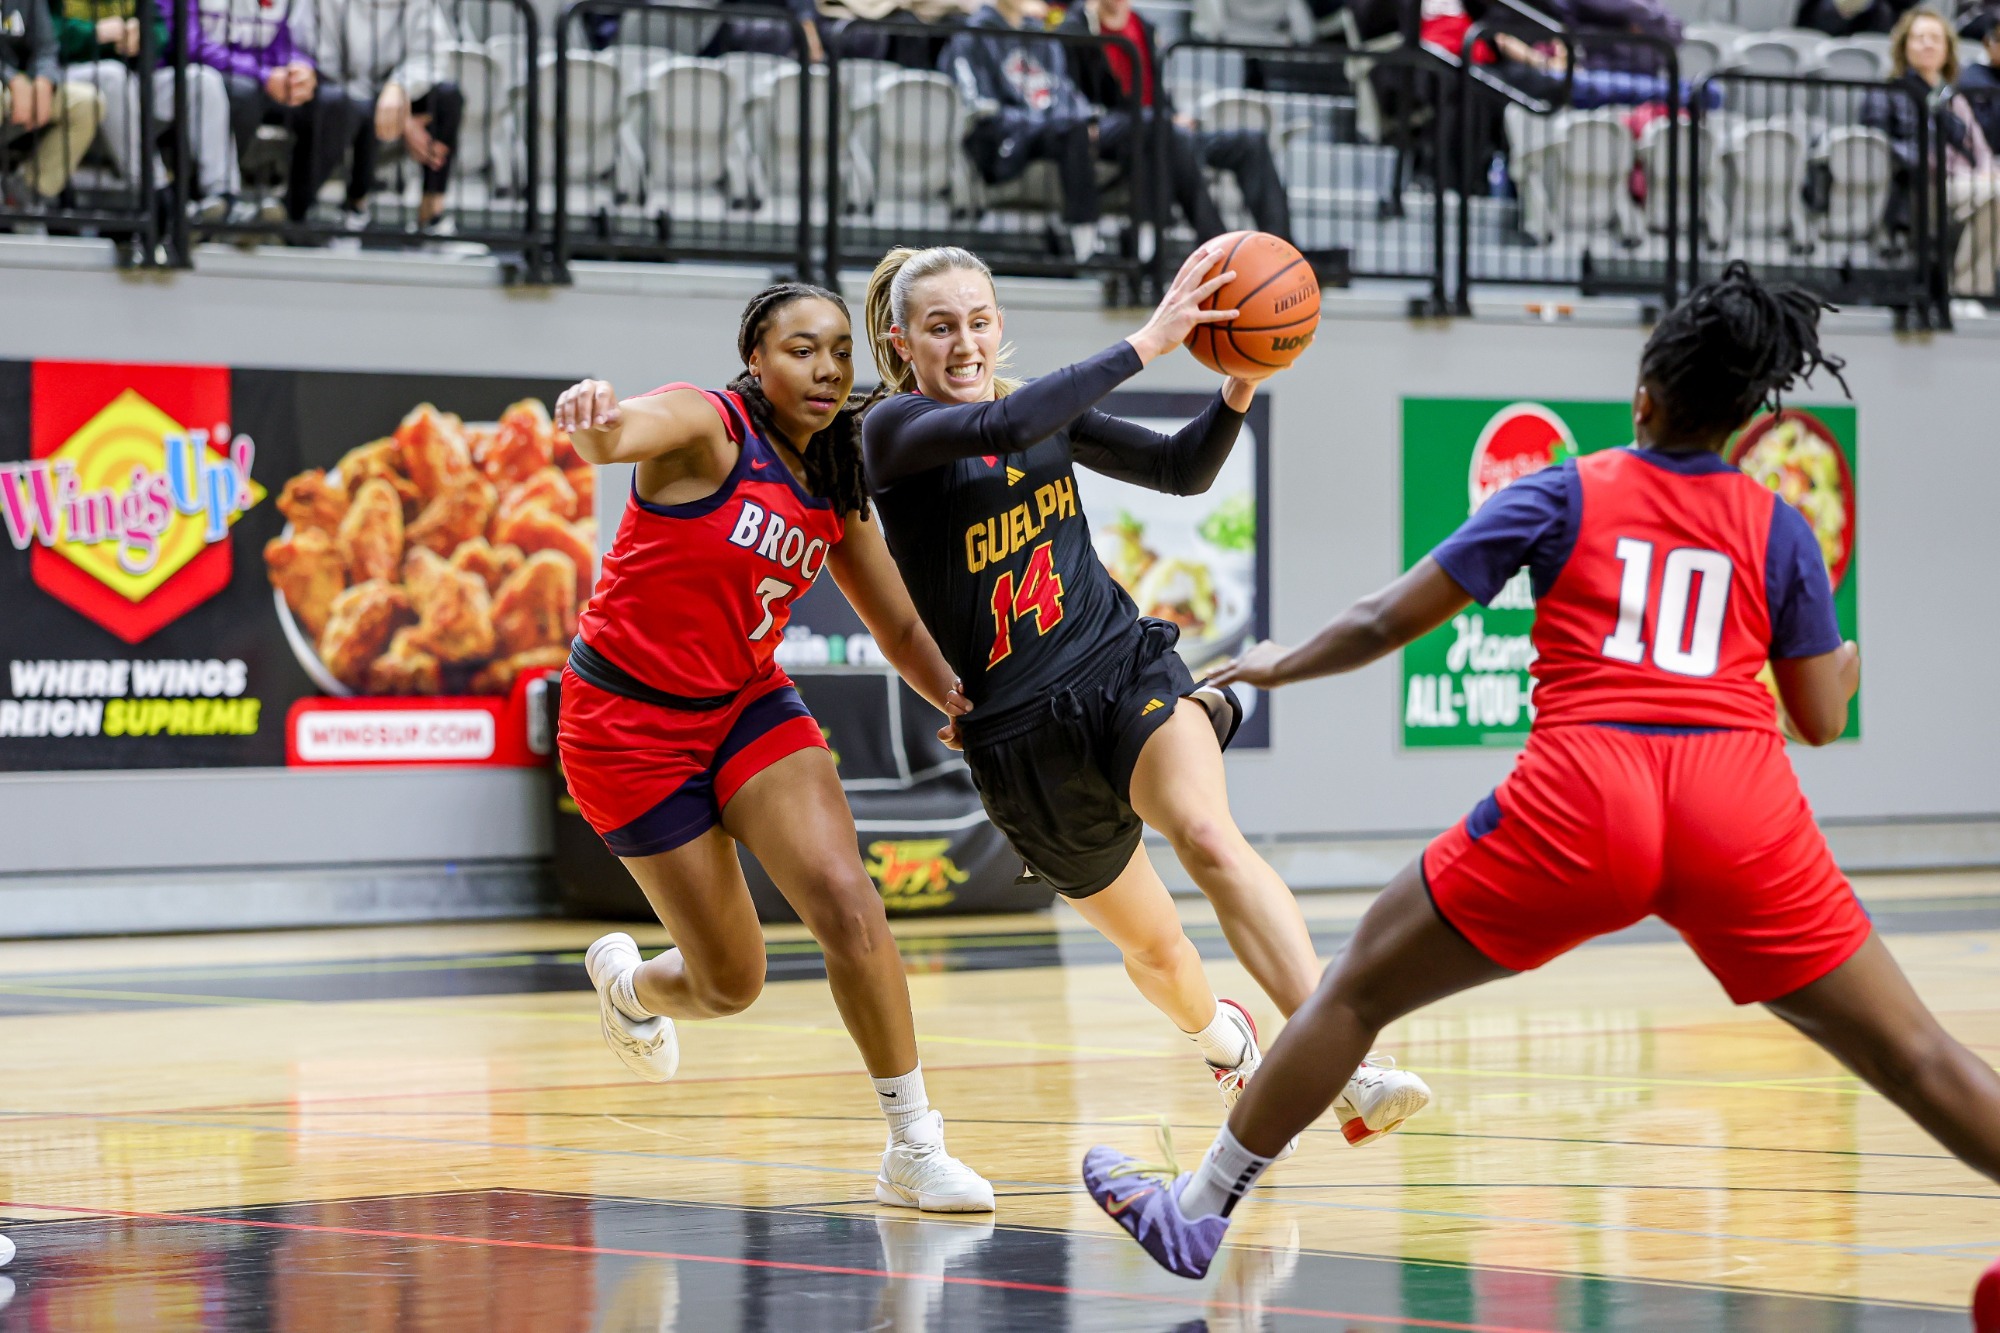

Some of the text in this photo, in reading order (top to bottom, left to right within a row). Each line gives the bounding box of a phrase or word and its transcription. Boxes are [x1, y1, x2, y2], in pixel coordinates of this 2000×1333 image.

[728, 499, 830, 584] BROC
[965, 476, 1077, 574] GUELPH
[748, 575, 795, 641] 7
[986, 540, 1064, 671] 14
[1601, 536, 1733, 678] 10
[10, 658, 248, 697] WHERE WINGS
[0, 697, 261, 737] REIGN SUPREME
[310, 725, 483, 745] WINGSUP.COM
